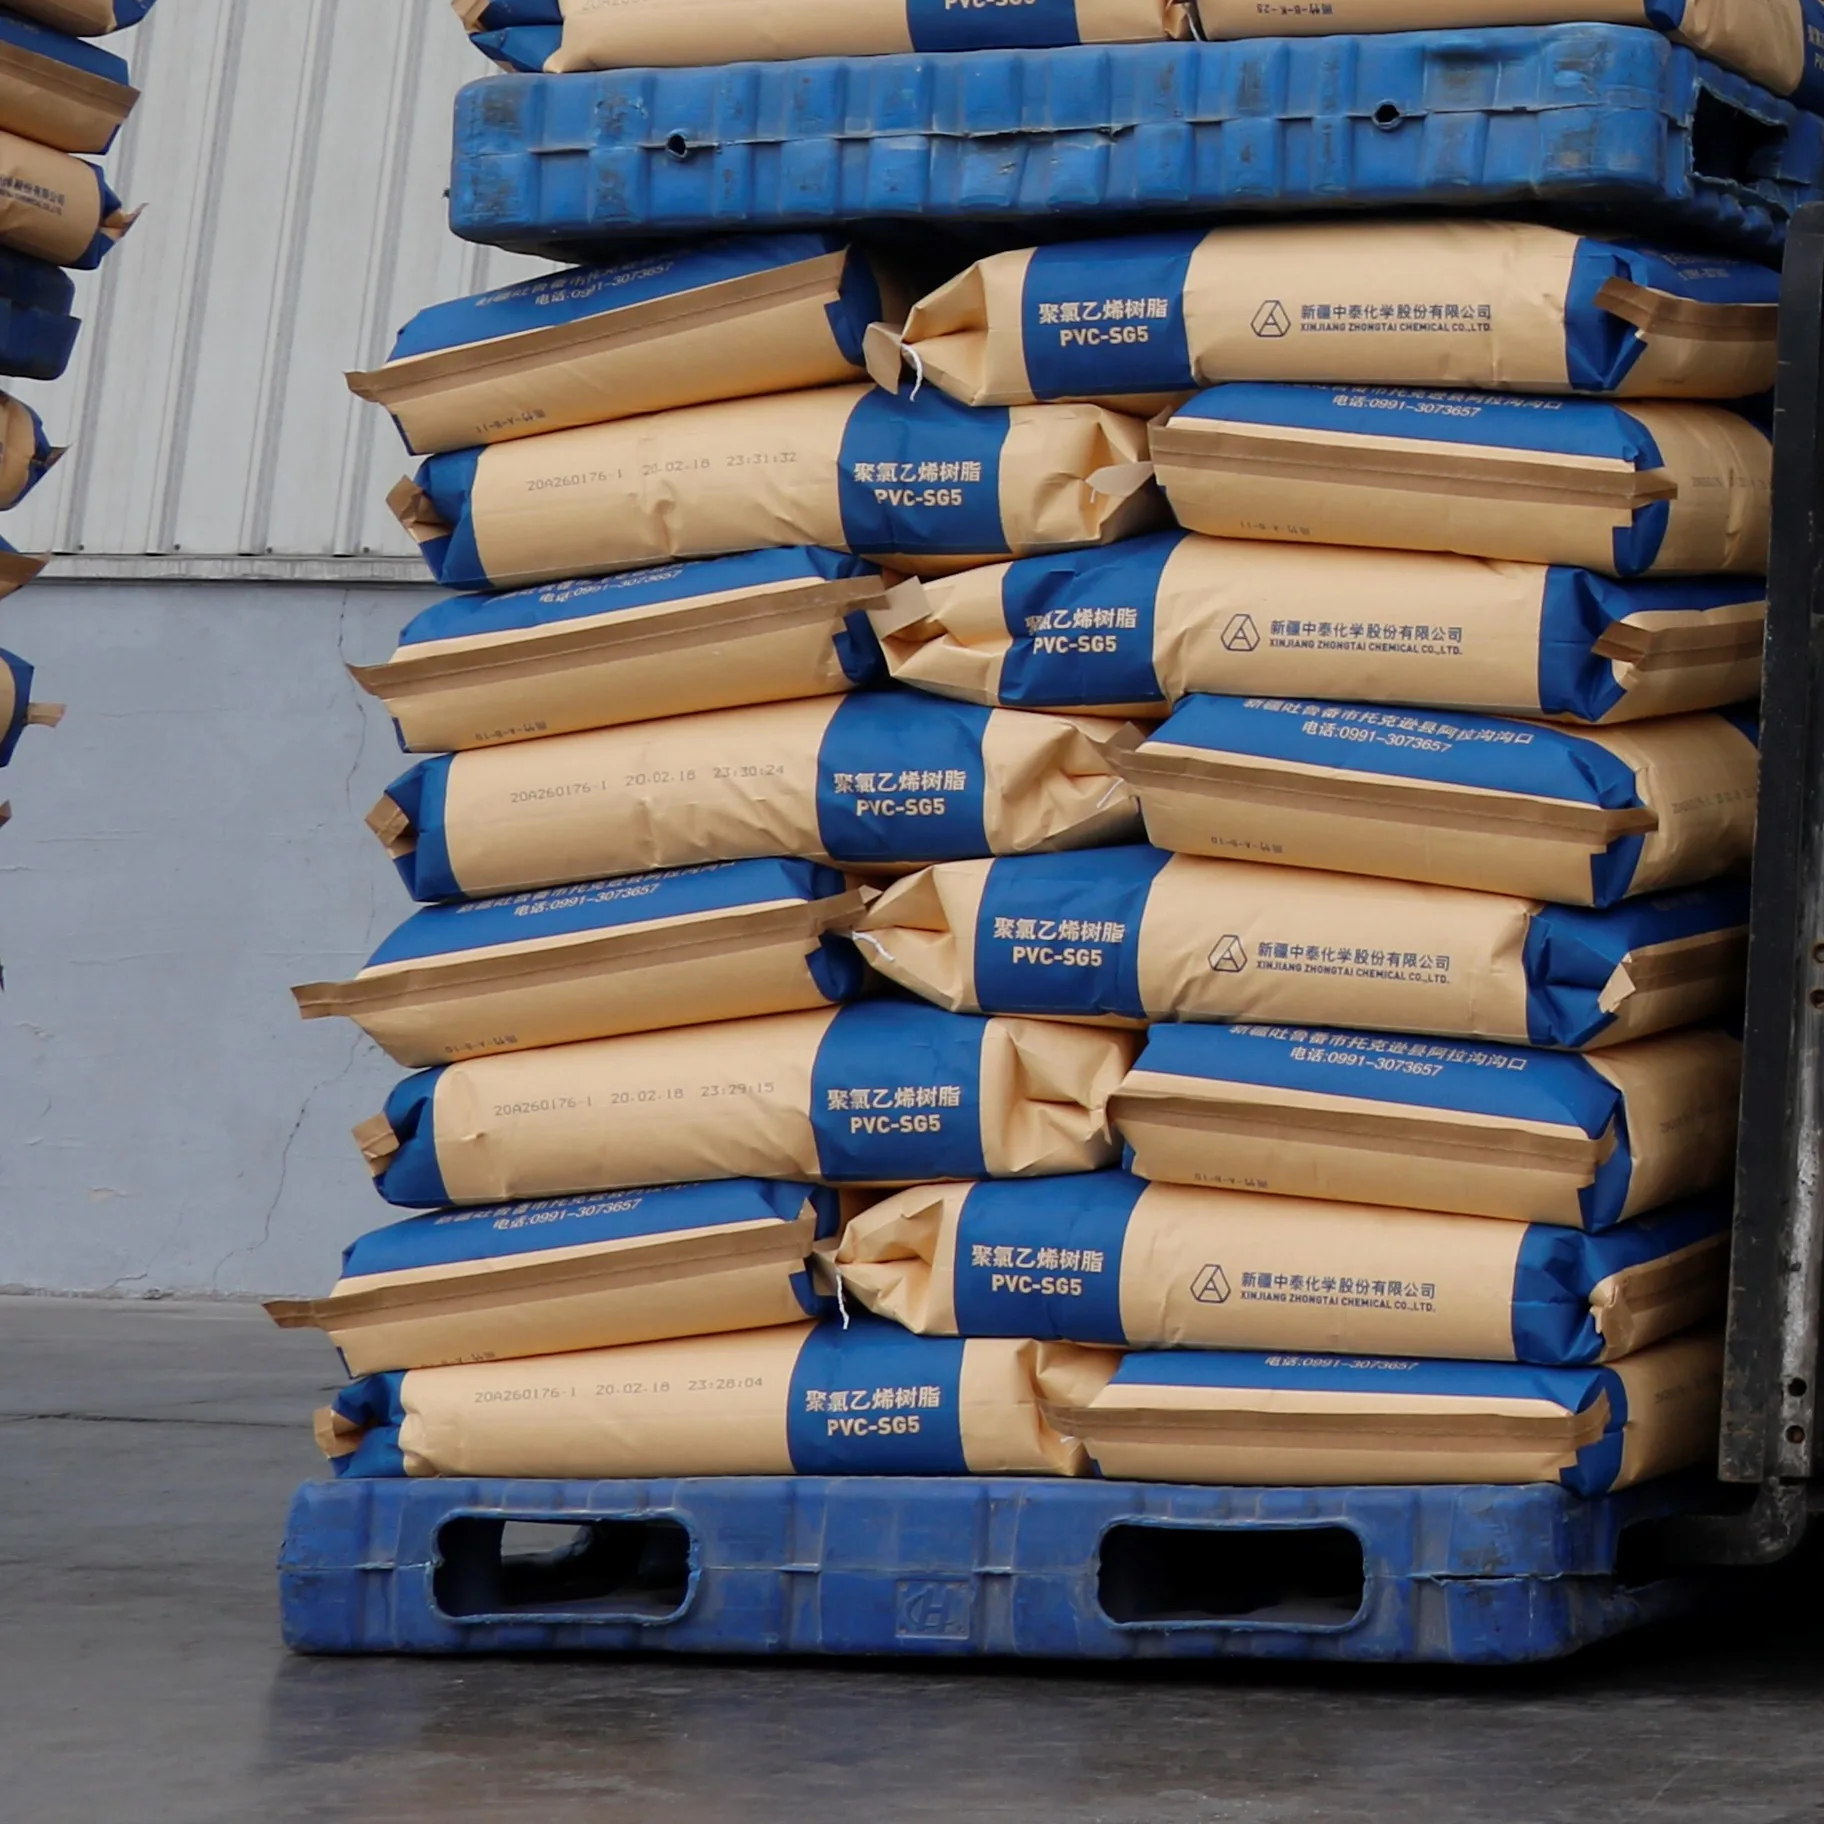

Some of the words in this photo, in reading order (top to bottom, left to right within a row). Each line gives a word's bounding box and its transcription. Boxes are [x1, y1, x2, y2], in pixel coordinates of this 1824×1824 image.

[1039, 297, 1167, 323] 聚氯乙烯树脂
[1301, 303, 1491, 320] 新疆中泰化学股份有限公司
[1059, 325, 1148, 346] PVC-SG5
[1300, 322, 1346, 331] XINJIANG
[1348, 322, 1397, 332] ZHONGTAI
[1398, 322, 1449, 332] CHEMICAL
[1332, 394, 1480, 416] 电话:0991-3073657
[854, 460, 980, 482] 聚氯乙烯树脂
[874, 488, 962, 506] PVC-SG5
[1270, 620, 1462, 641] 新疆中泰化学股份有限公司
[1033, 634, 1116, 653] PVC-SG5
[1269, 638, 1314, 648] XINJIANG
[1317, 639, 1366, 651] ZHONGTAI
[1368, 642, 1419, 653] CHEMICAL
[1243, 698, 1533, 744] 新疆吐鲁番市托克逊县阿拉沟沟口
[1302, 721, 1450, 751] 电话:0991-3073657
[834, 769, 966, 792] 聚氯乙烯树脂
[856, 797, 945, 816] PVC-SG5
[514, 883, 658, 916] 电话:0991-3073657
[994, 917, 1124, 942] 聚氯乙烯树脂
[1012, 945, 1102, 966] PVC-SG5
[1258, 942, 1449, 969] 新疆中泰化学股份有限公司
[1256, 960, 1302, 972] XINJIANG
[1304, 963, 1353, 976] ZHONGTAI
[1355, 967, 1405, 980] CHEMICAL
[1231, 1025, 1525, 1069] 新疆吐鲁番市托克逊县阿拉沟沟口
[1290, 1046, 1442, 1075] 电话:0991-3073657
[610, 1088, 684, 1103] 20.02.18
[827, 1085, 960, 1109] 聚氯乙烯树脂
[850, 1113, 940, 1133] PVC-SG5
[493, 1198, 641, 1229] 电话:0991-3073657
[972, 1244, 1103, 1272] 聚氯乙烯树脂
[991, 1273, 1082, 1295] PVC-SG5
[1241, 1271, 1435, 1298] 新疆中泰化学股份有限公司
[1240, 1290, 1286, 1302] XINJIANG
[1288, 1293, 1338, 1305] ZHONGTAI
[1340, 1296, 1391, 1309] CHEMICAL
[595, 1381, 670, 1394] 20.02.18
[688, 1376, 764, 1390] 23:28:04
[806, 1385, 940, 1411] 聚氯乙烯树脂
[827, 1415, 920, 1436] PVC-SG5
